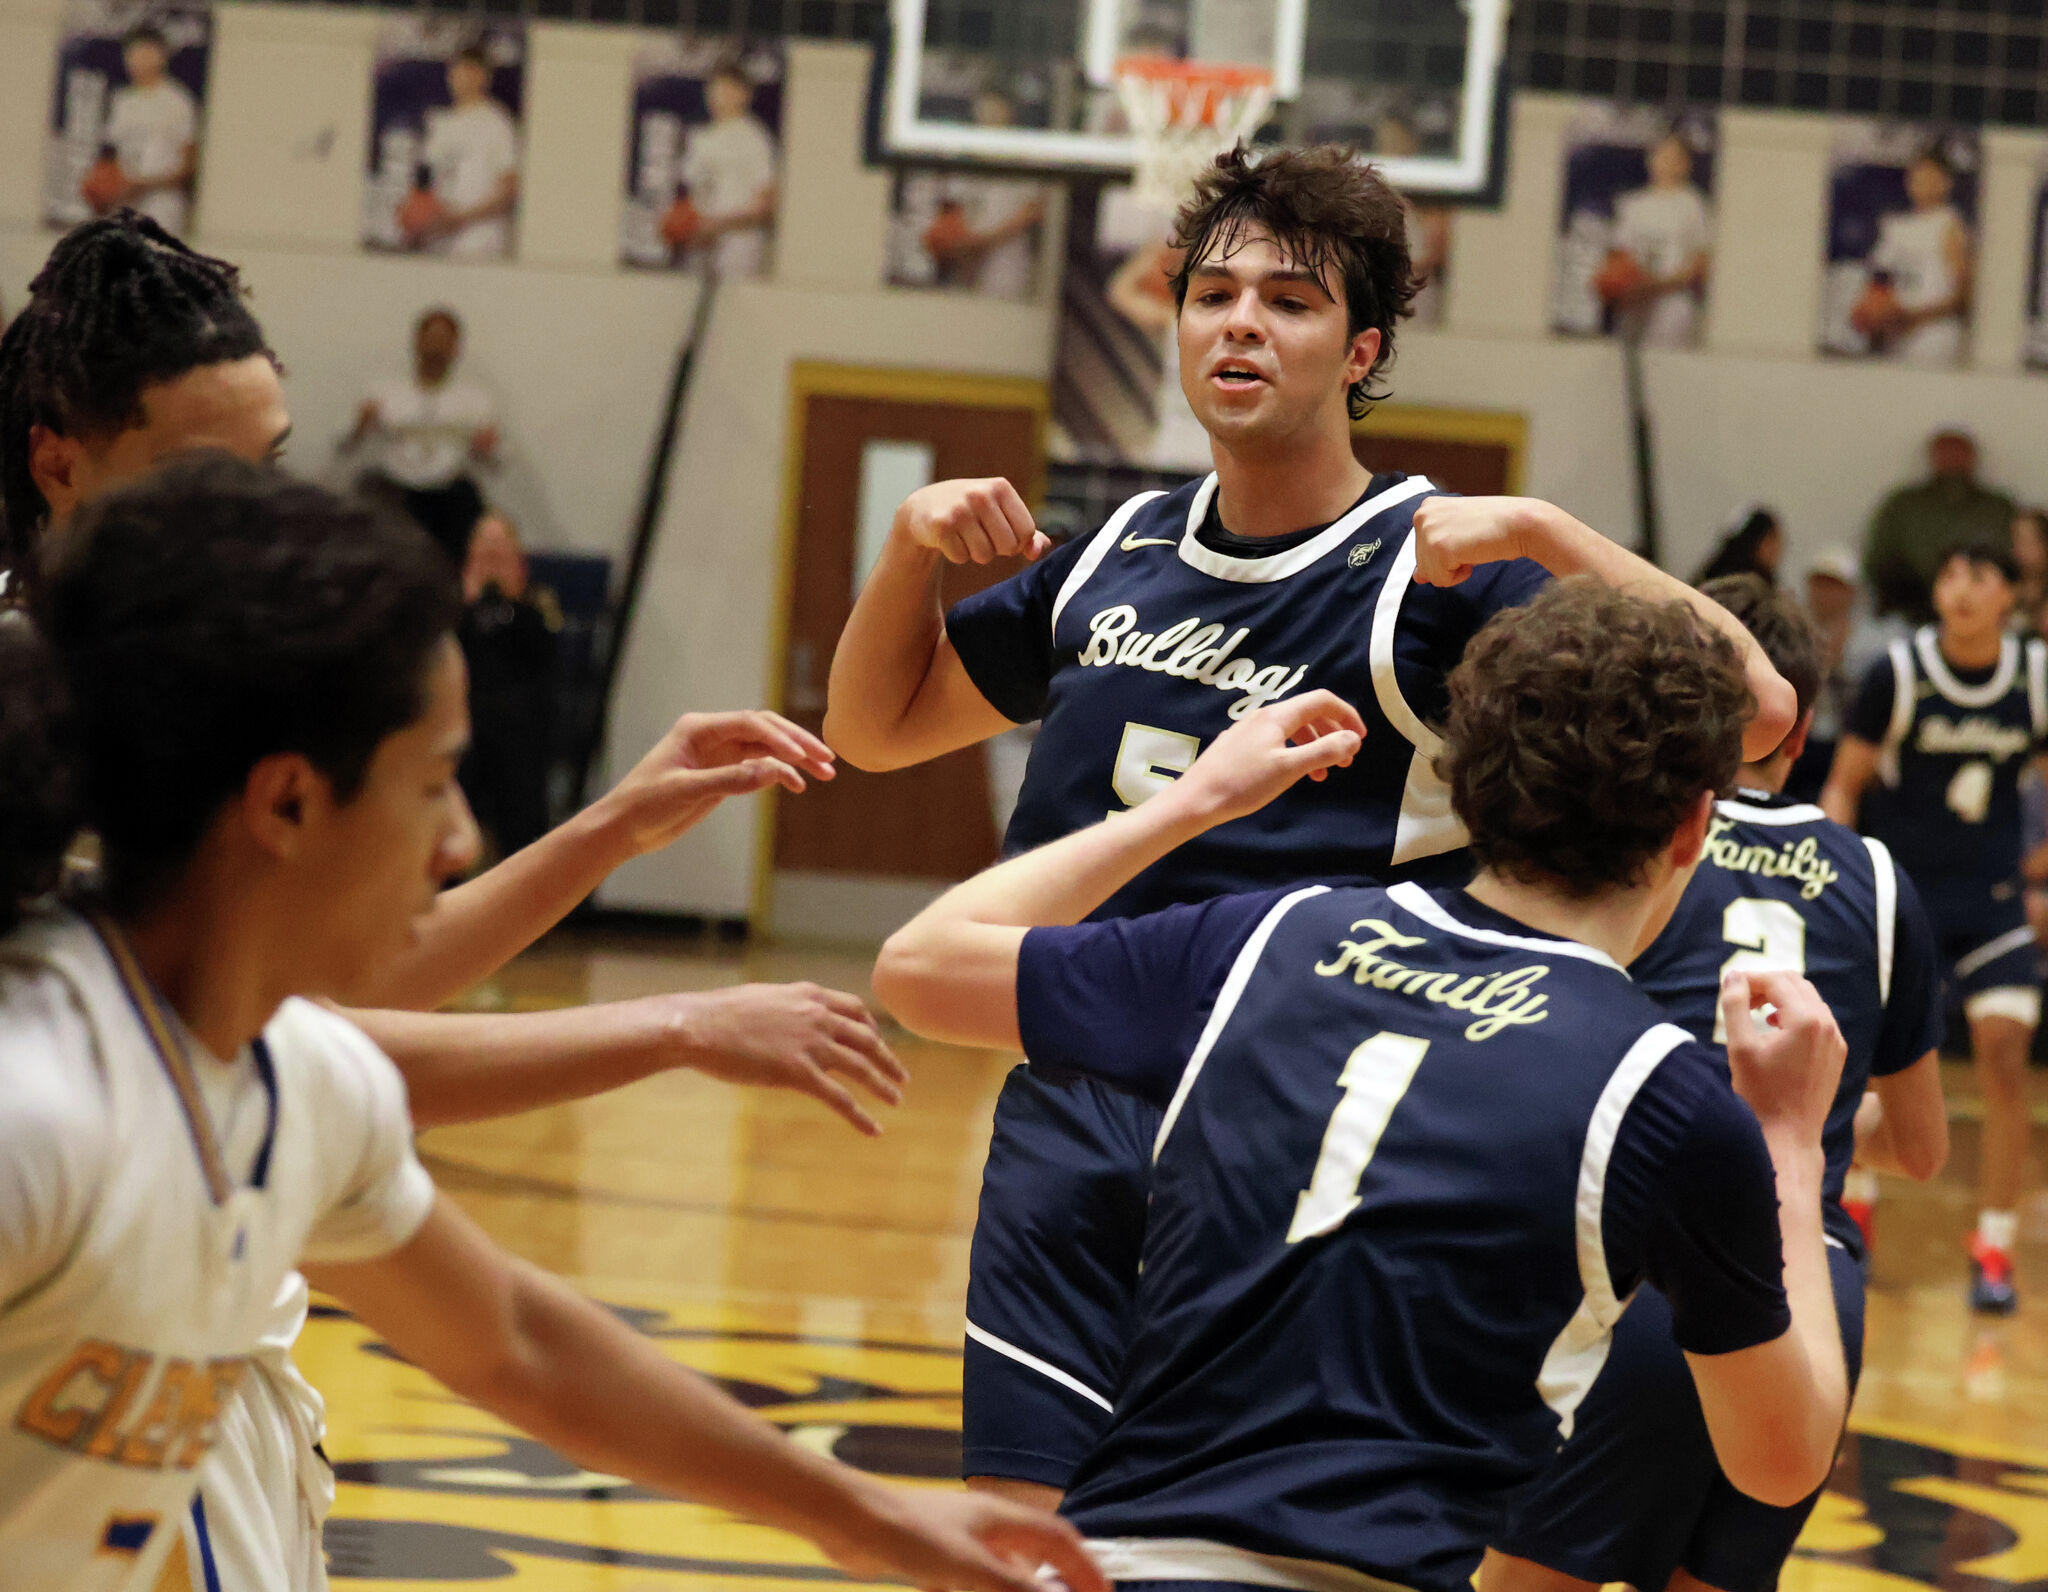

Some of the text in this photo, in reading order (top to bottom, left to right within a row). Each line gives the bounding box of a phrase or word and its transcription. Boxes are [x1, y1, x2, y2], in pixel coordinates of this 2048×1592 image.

[1699, 817, 1838, 901] Family
[1314, 918, 1550, 1042] Family
[1712, 896, 1806, 1045] 2
[1286, 1031, 1431, 1243] 1
